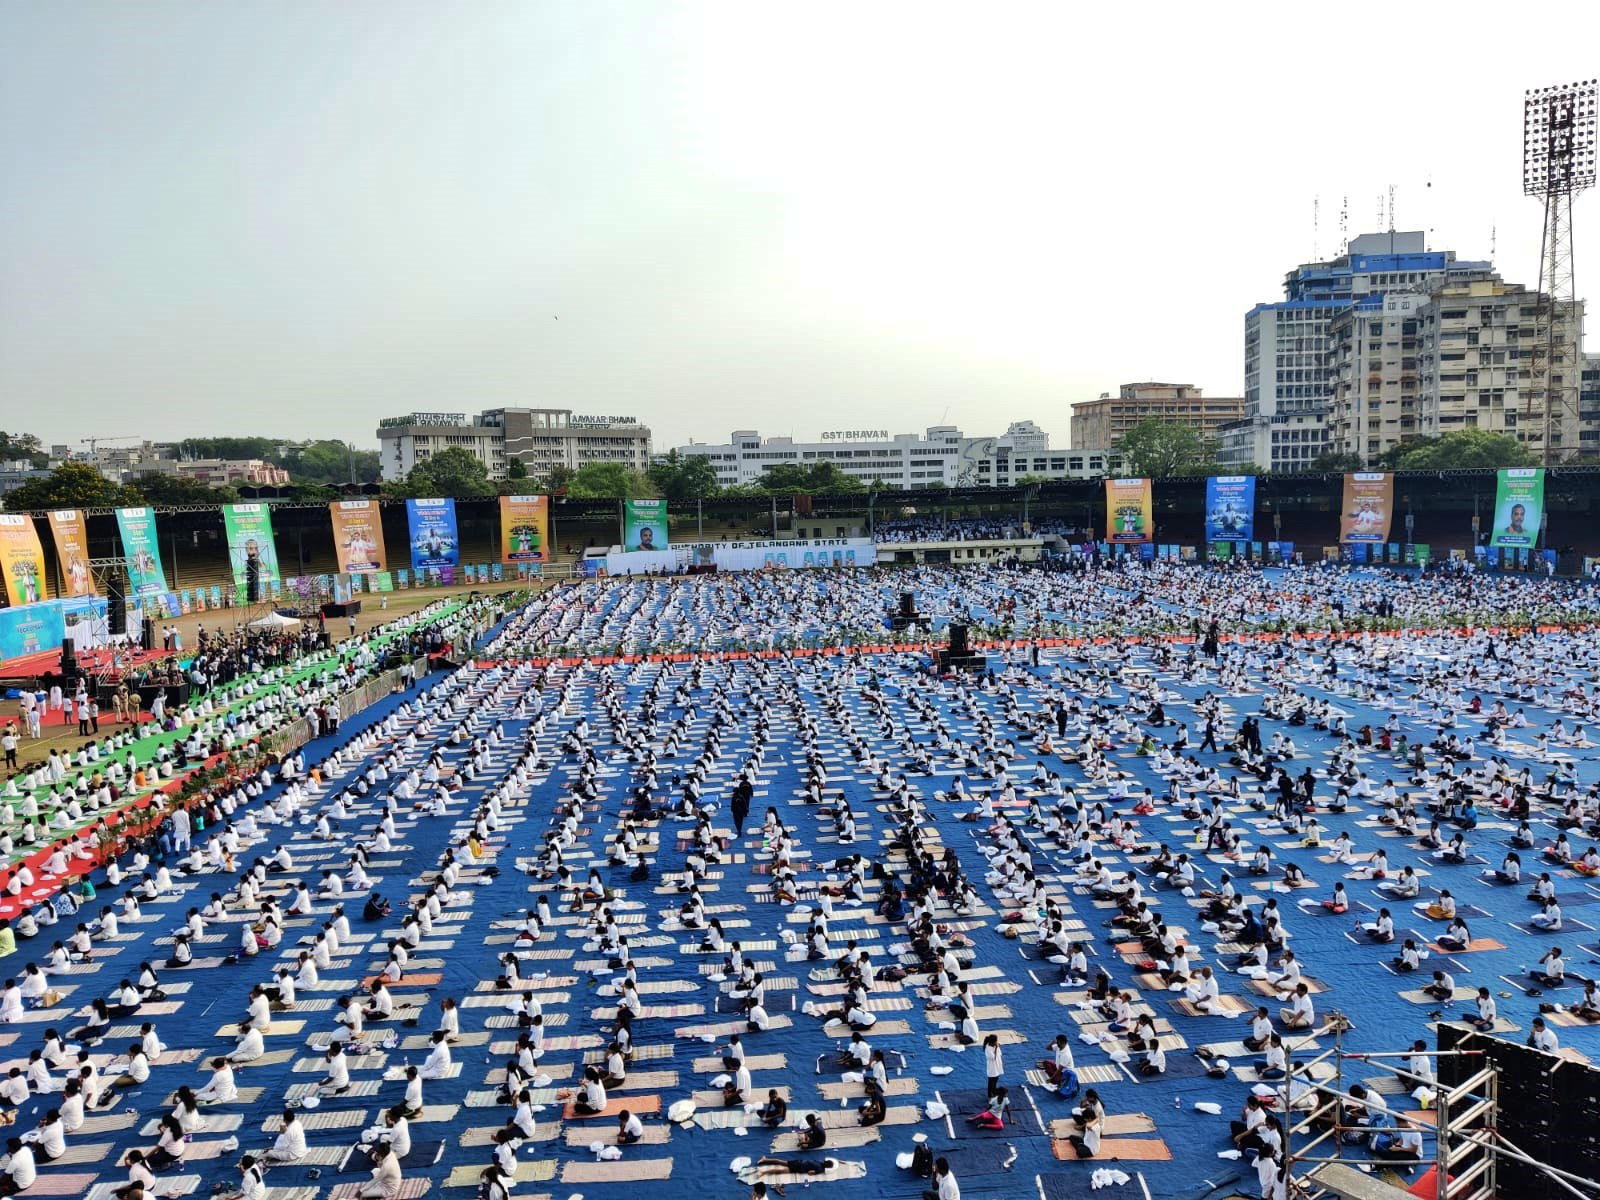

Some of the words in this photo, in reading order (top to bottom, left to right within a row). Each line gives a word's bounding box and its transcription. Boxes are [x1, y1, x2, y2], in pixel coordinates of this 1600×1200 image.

[572, 414, 607, 424] AAYAKAR
[608, 415, 637, 425] BHAVAN
[822, 431, 843, 439] GST
[845, 430, 888, 439] BHAVAN
[731, 542, 745, 550] OF
[748, 540, 809, 550] TELANGANA
[814, 539, 847, 547] STATE
